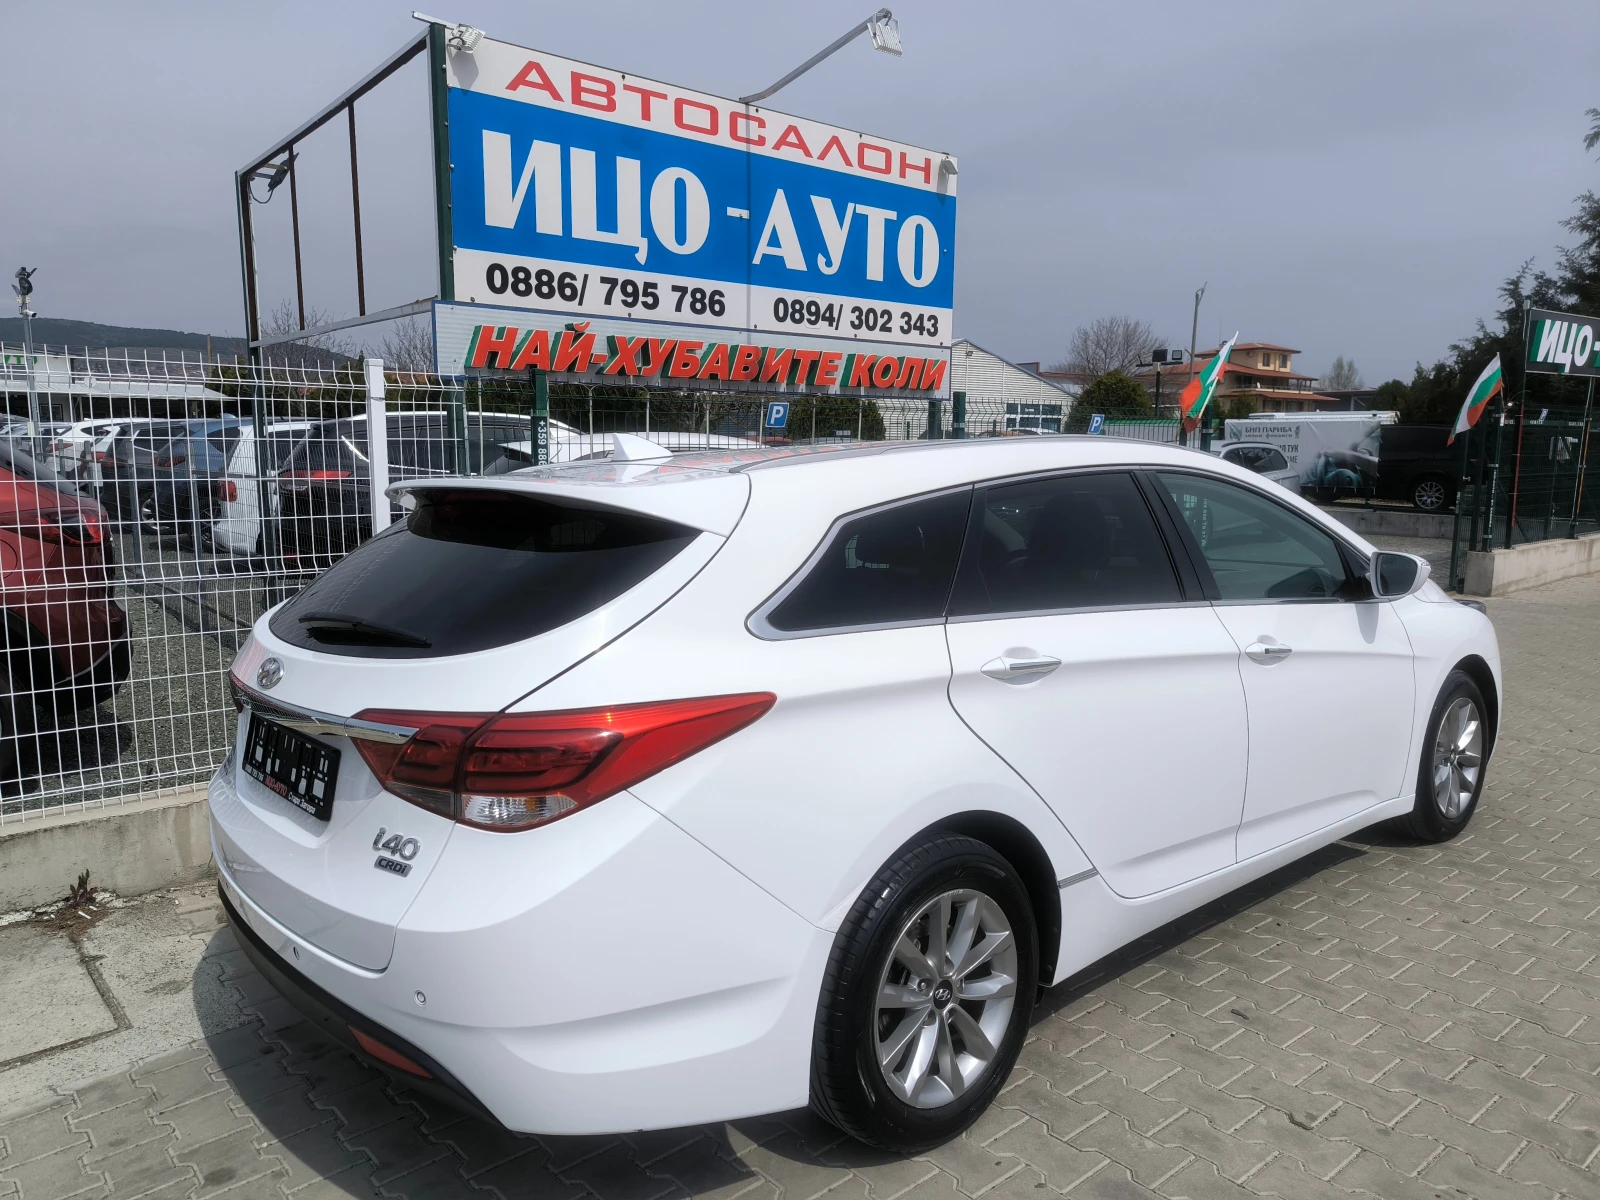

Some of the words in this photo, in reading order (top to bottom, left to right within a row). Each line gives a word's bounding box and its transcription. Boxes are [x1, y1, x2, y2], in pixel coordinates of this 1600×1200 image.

[505, 60, 932, 185] АВТОСАЛОН
[485, 262, 589, 307] 0886/
[599, 276, 660, 310] 795
[671, 284, 726, 318] 786
[773, 296, 844, 331] 0894/
[849, 305, 893, 334] 302
[899, 311, 939, 338] 343
[466, 321, 843, 387] НАЙ-ХУБАВИТЕ
[843, 352, 947, 391] КОЛИ
[537, 420, 547, 445] +359
[770, 405, 785, 425] P
[372, 826, 421, 862] i40
[378, 858, 408, 874] CRDi
